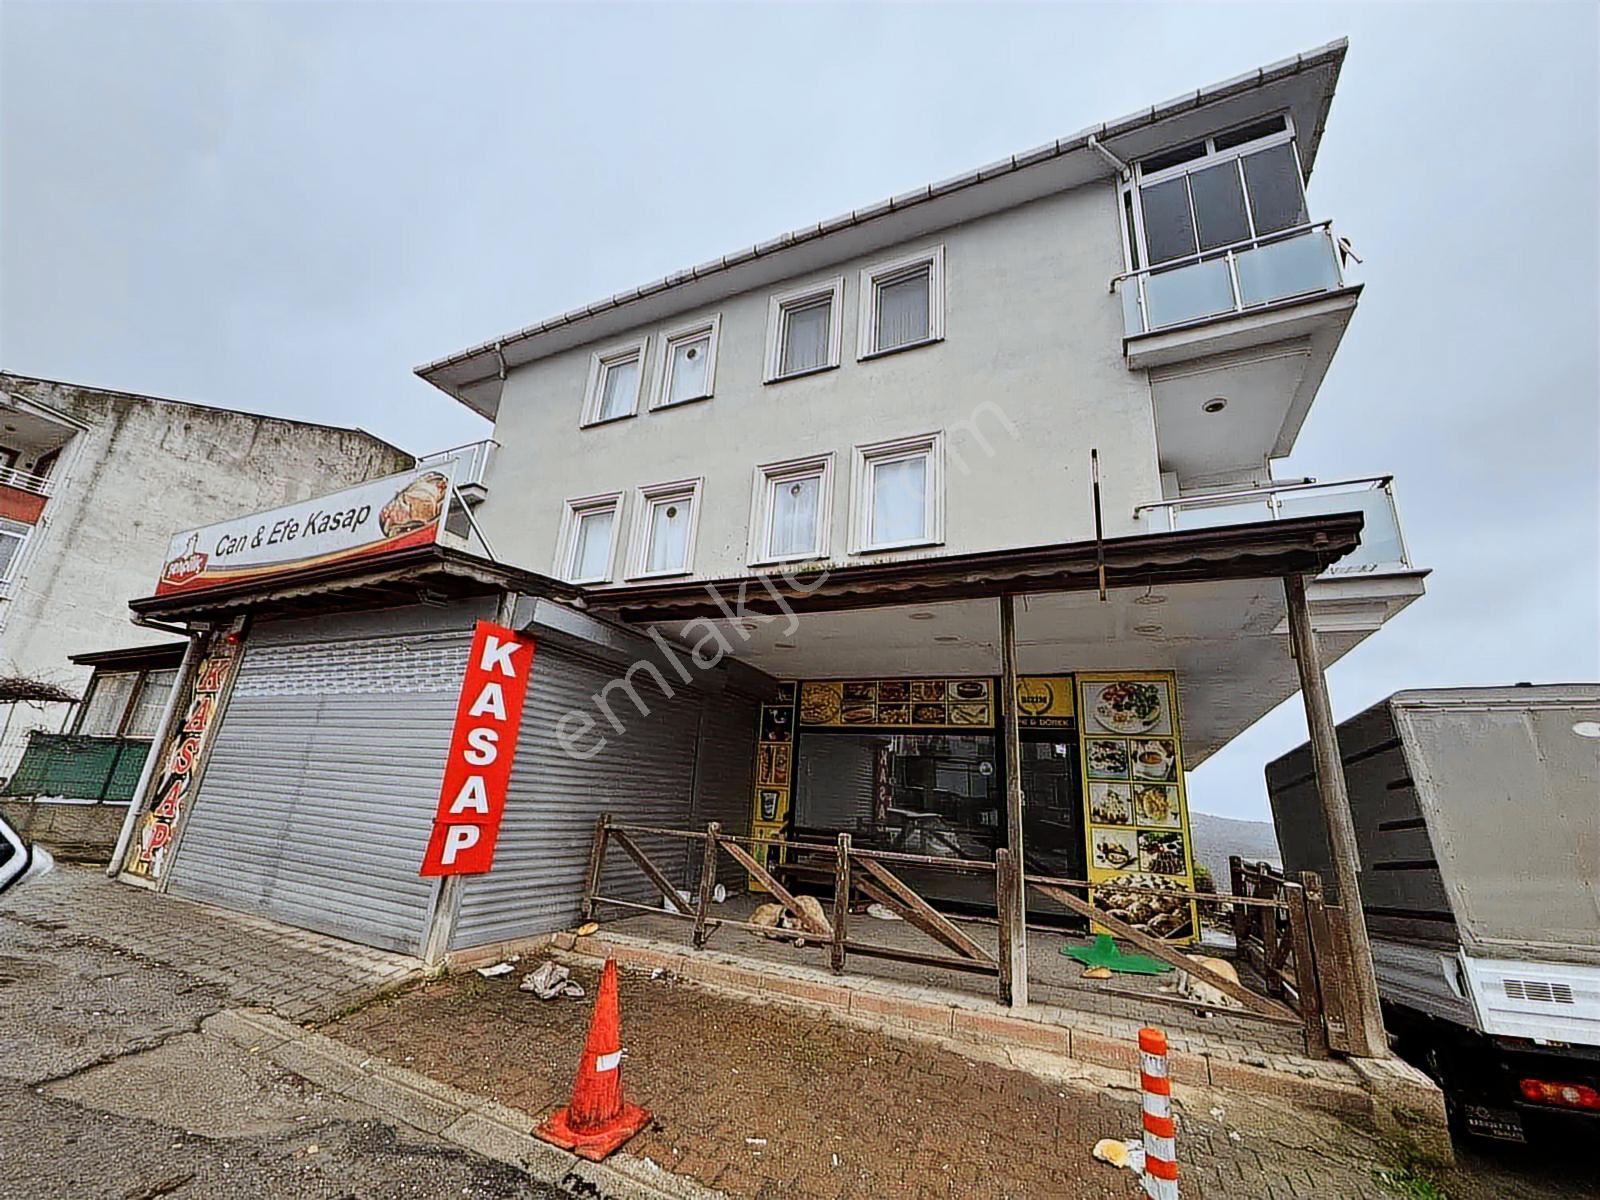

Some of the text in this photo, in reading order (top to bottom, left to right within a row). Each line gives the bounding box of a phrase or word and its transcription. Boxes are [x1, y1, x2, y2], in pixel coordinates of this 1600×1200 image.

[215, 504, 371, 557] Can & Efe Kasap
[139, 657, 231, 862] KASAP
[440, 634, 524, 866] KASAP
